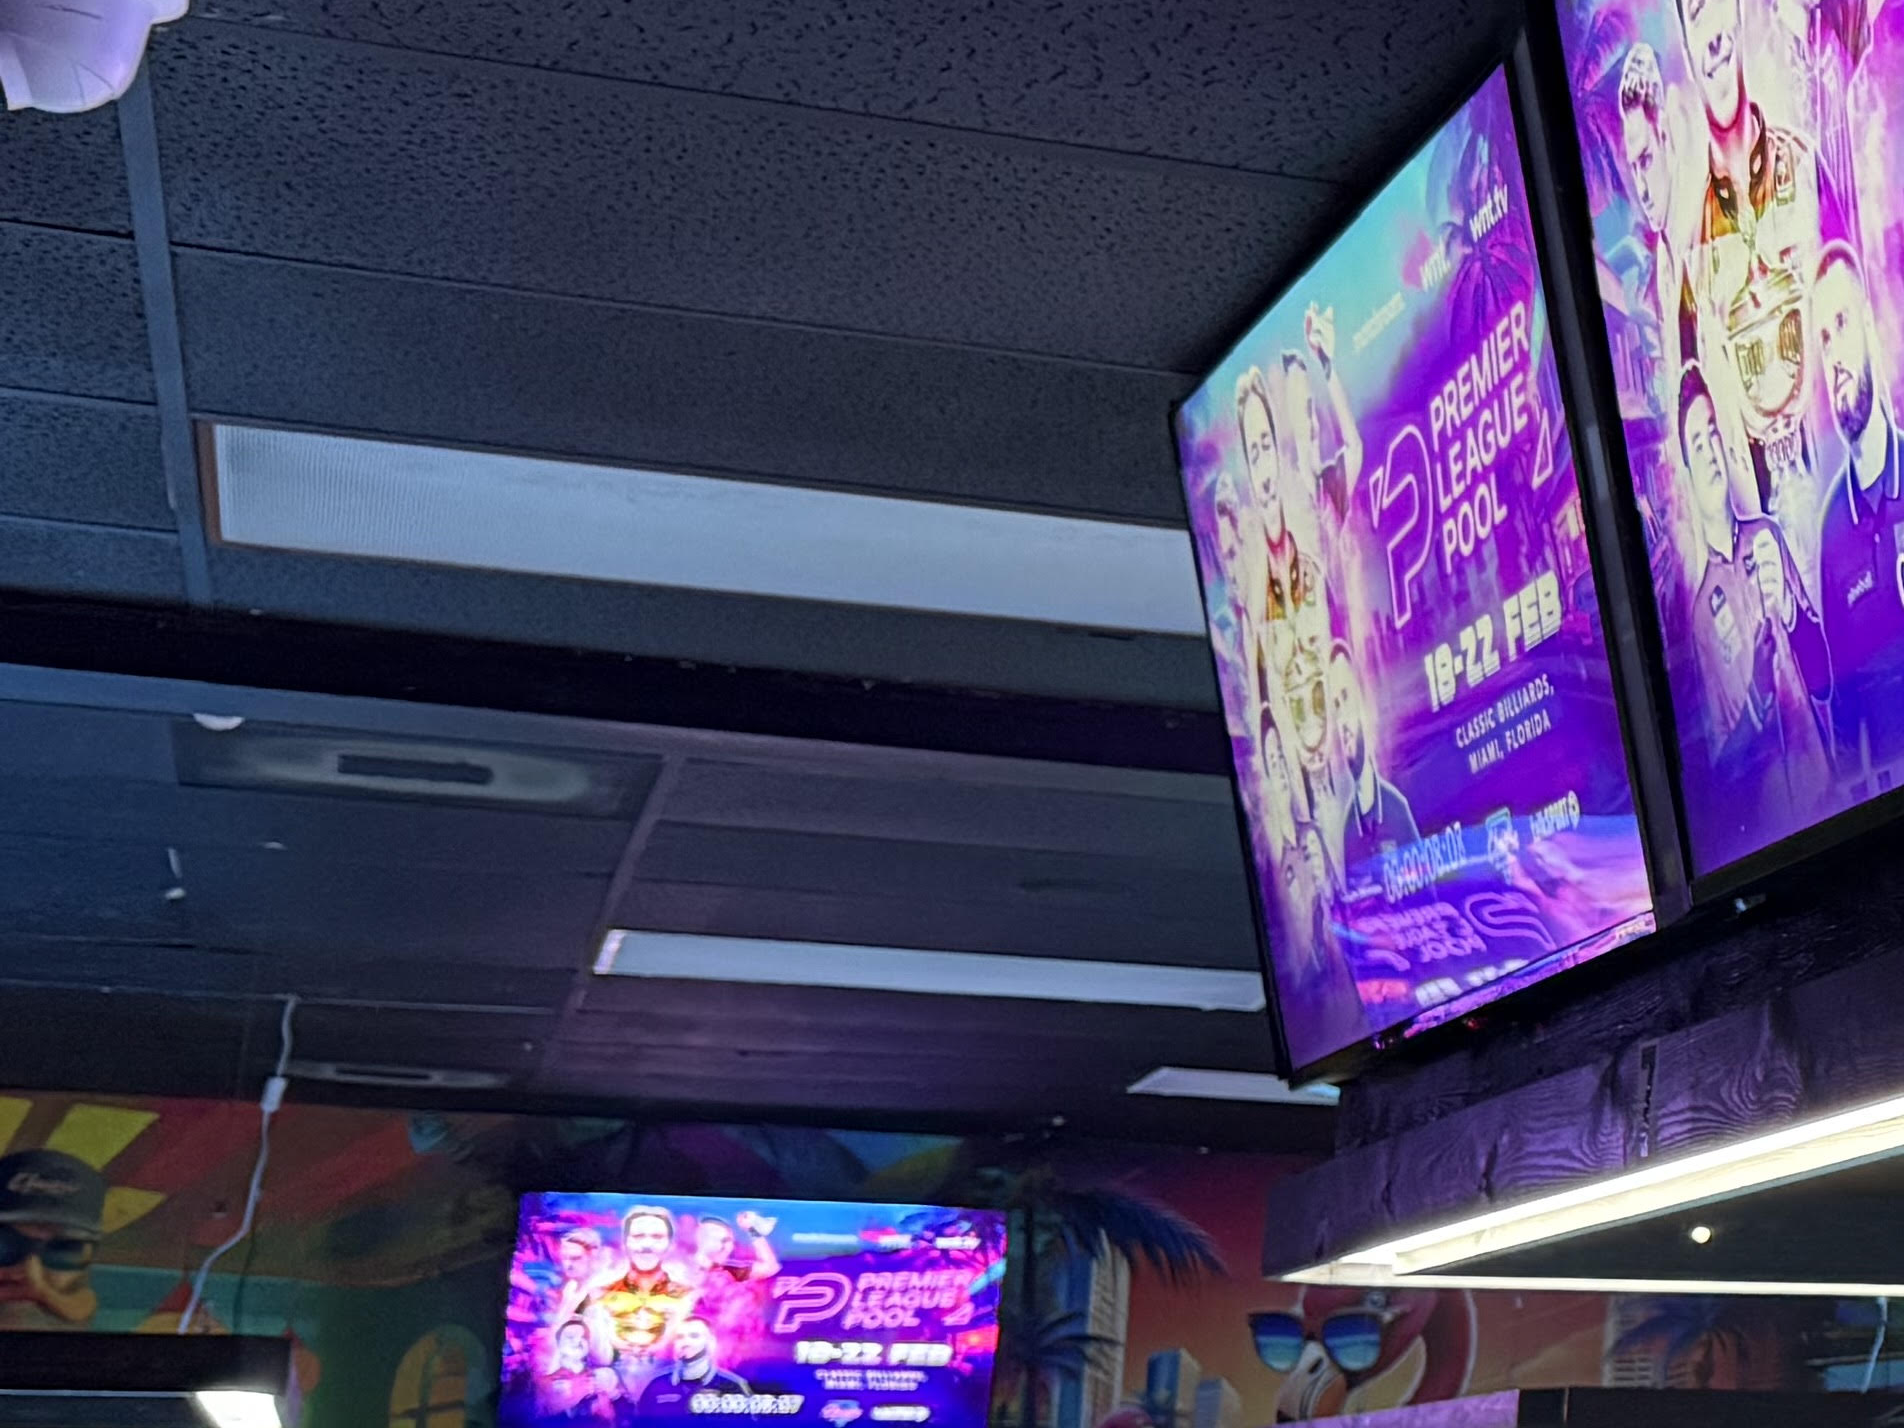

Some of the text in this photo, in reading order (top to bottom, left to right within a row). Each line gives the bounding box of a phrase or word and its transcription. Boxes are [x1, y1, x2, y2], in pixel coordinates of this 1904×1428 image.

[1430, 300, 1530, 453] PREMIER
[1435, 373, 1530, 509] LEAGUE
[1441, 478, 1508, 574] POOL
[1424, 569, 1562, 714] 18-22 FEB
[841, 1307, 922, 1330] POOL
[851, 1289, 958, 1310] LEAGUE
[856, 1270, 975, 1292] PREMIER
